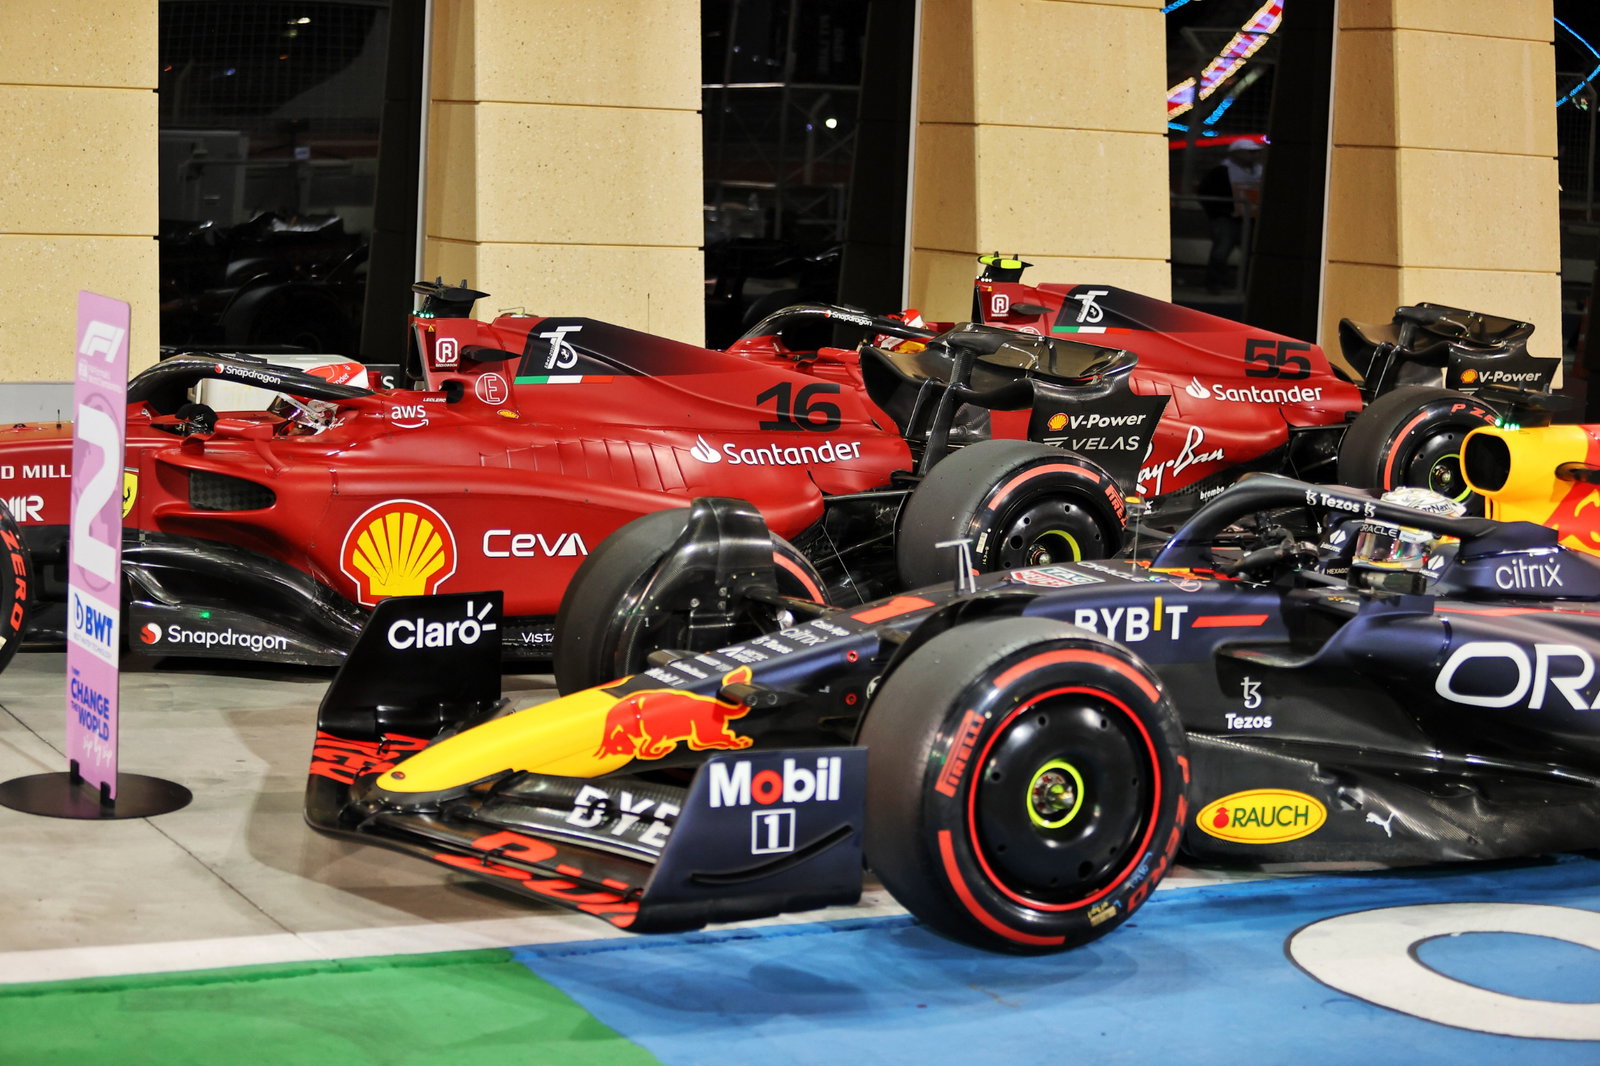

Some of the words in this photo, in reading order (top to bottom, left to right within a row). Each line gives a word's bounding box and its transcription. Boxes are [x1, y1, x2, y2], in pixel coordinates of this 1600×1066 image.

[831, 311, 872, 326] Snapdragon
[79, 320, 125, 363] F1
[1245, 338, 1311, 379] 55
[225, 365, 281, 385] Snapdragon
[1479, 371, 1542, 383] V-Power
[757, 382, 841, 432] 16
[1212, 385, 1322, 403] Santander
[391, 404, 426, 420] aws
[1070, 413, 1146, 430] V-Power
[723, 440, 860, 465] Santander
[1072, 435, 1140, 451] VELAS
[23, 464, 72, 479] MILL
[73, 404, 121, 584] 2
[1320, 493, 1360, 513] Tezos
[1360, 523, 1399, 538] RACLE
[0, 530, 26, 631] ZERO
[1326, 567, 1350, 575] HEXAGO
[1495, 558, 1564, 590] citrix
[85, 605, 113, 648] BWT
[1074, 596, 1189, 642] BYBIT
[167, 624, 287, 652] Snapdragon
[1435, 641, 1600, 711] OR
[71, 678, 110, 721] CHANGE
[78, 710, 109, 741] WORLD
[1224, 713, 1272, 730] Tezos
[934, 709, 986, 798] PIRELLI
[709, 757, 842, 808] Mobil
[1231, 805, 1309, 828] RAUCH
[1127, 793, 1188, 912] ZERO
